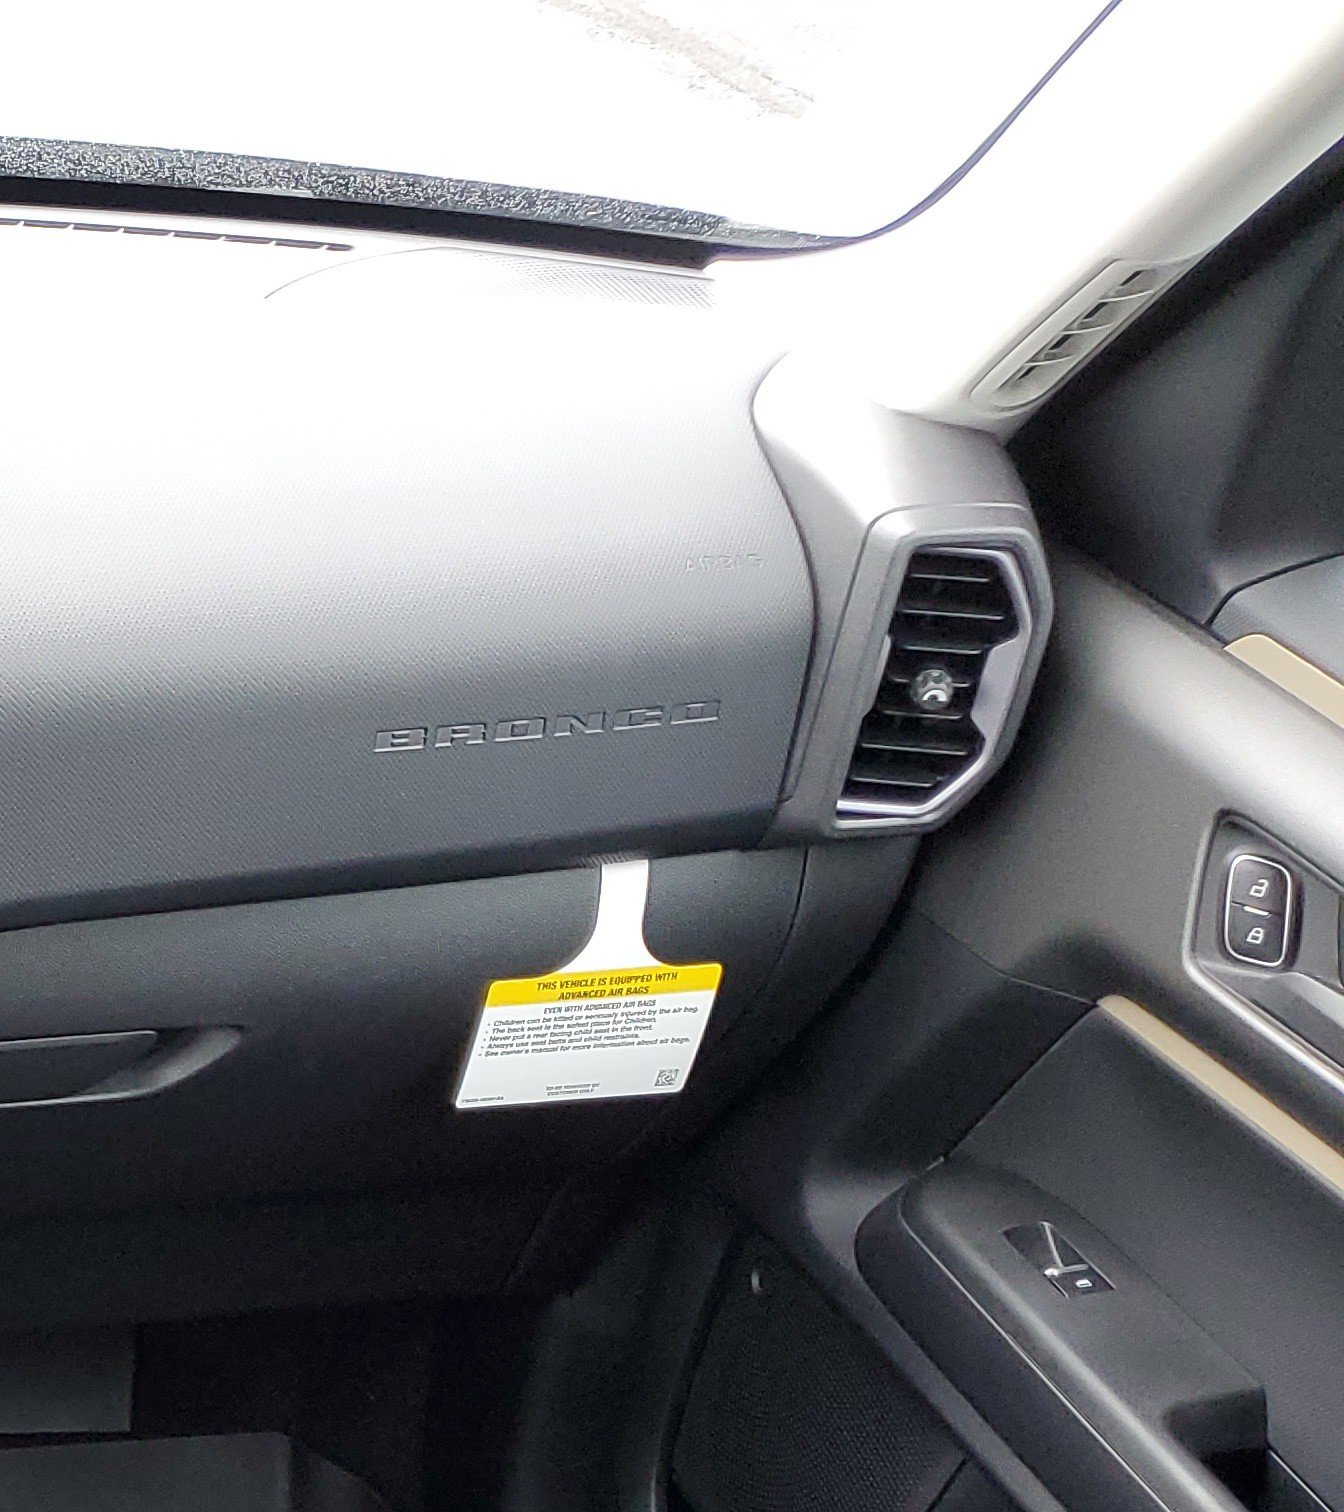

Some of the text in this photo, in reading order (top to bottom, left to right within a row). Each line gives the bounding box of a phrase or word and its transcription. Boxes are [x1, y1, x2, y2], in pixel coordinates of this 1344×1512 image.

[374, 700, 720, 752] BRONCO
[537, 972, 678, 991] THIS VEHICLE IS EQUIPPED WITH
[558, 986, 649, 1000] ADVANCED AIR BAGS
